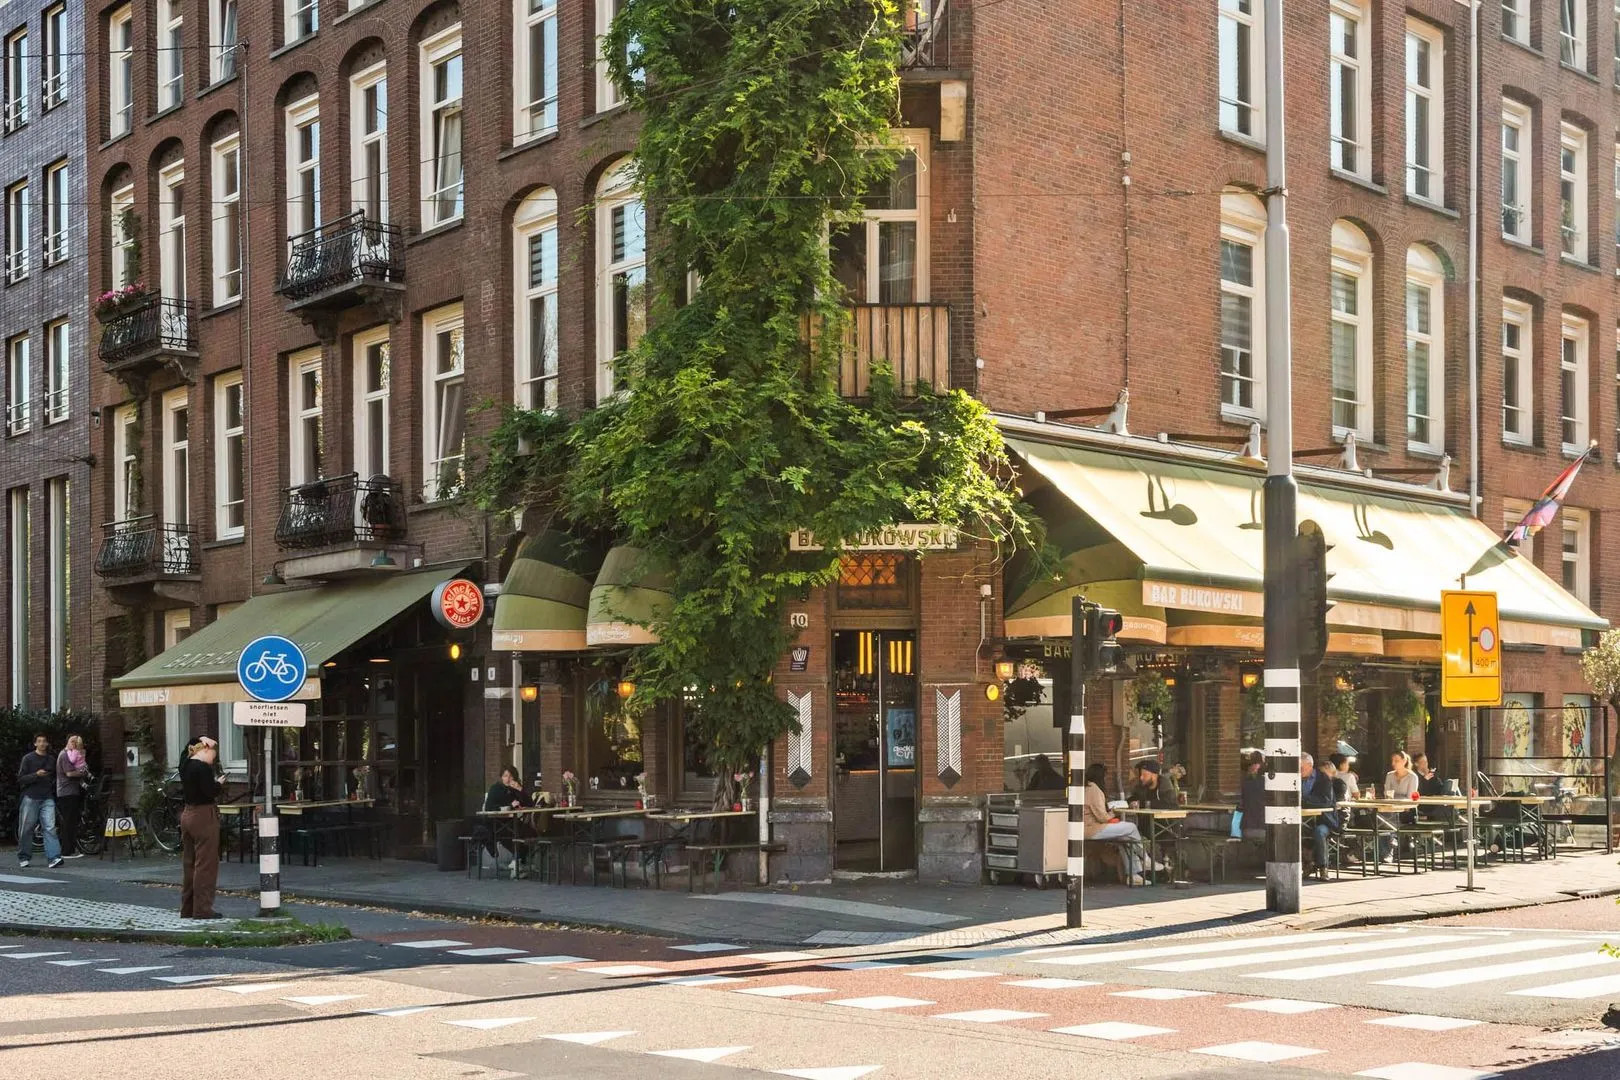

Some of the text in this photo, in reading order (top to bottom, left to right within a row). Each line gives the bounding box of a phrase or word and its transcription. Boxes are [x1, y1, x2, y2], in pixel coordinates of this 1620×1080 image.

[845, 527, 954, 546] UKOWSKI
[1151, 585, 1243, 610] BAR BUKOWSKI
[452, 613, 471, 623] Bier
[793, 614, 806, 626] 10
[1044, 645, 1072, 658] BAR
[1475, 656, 1489, 668] 400
